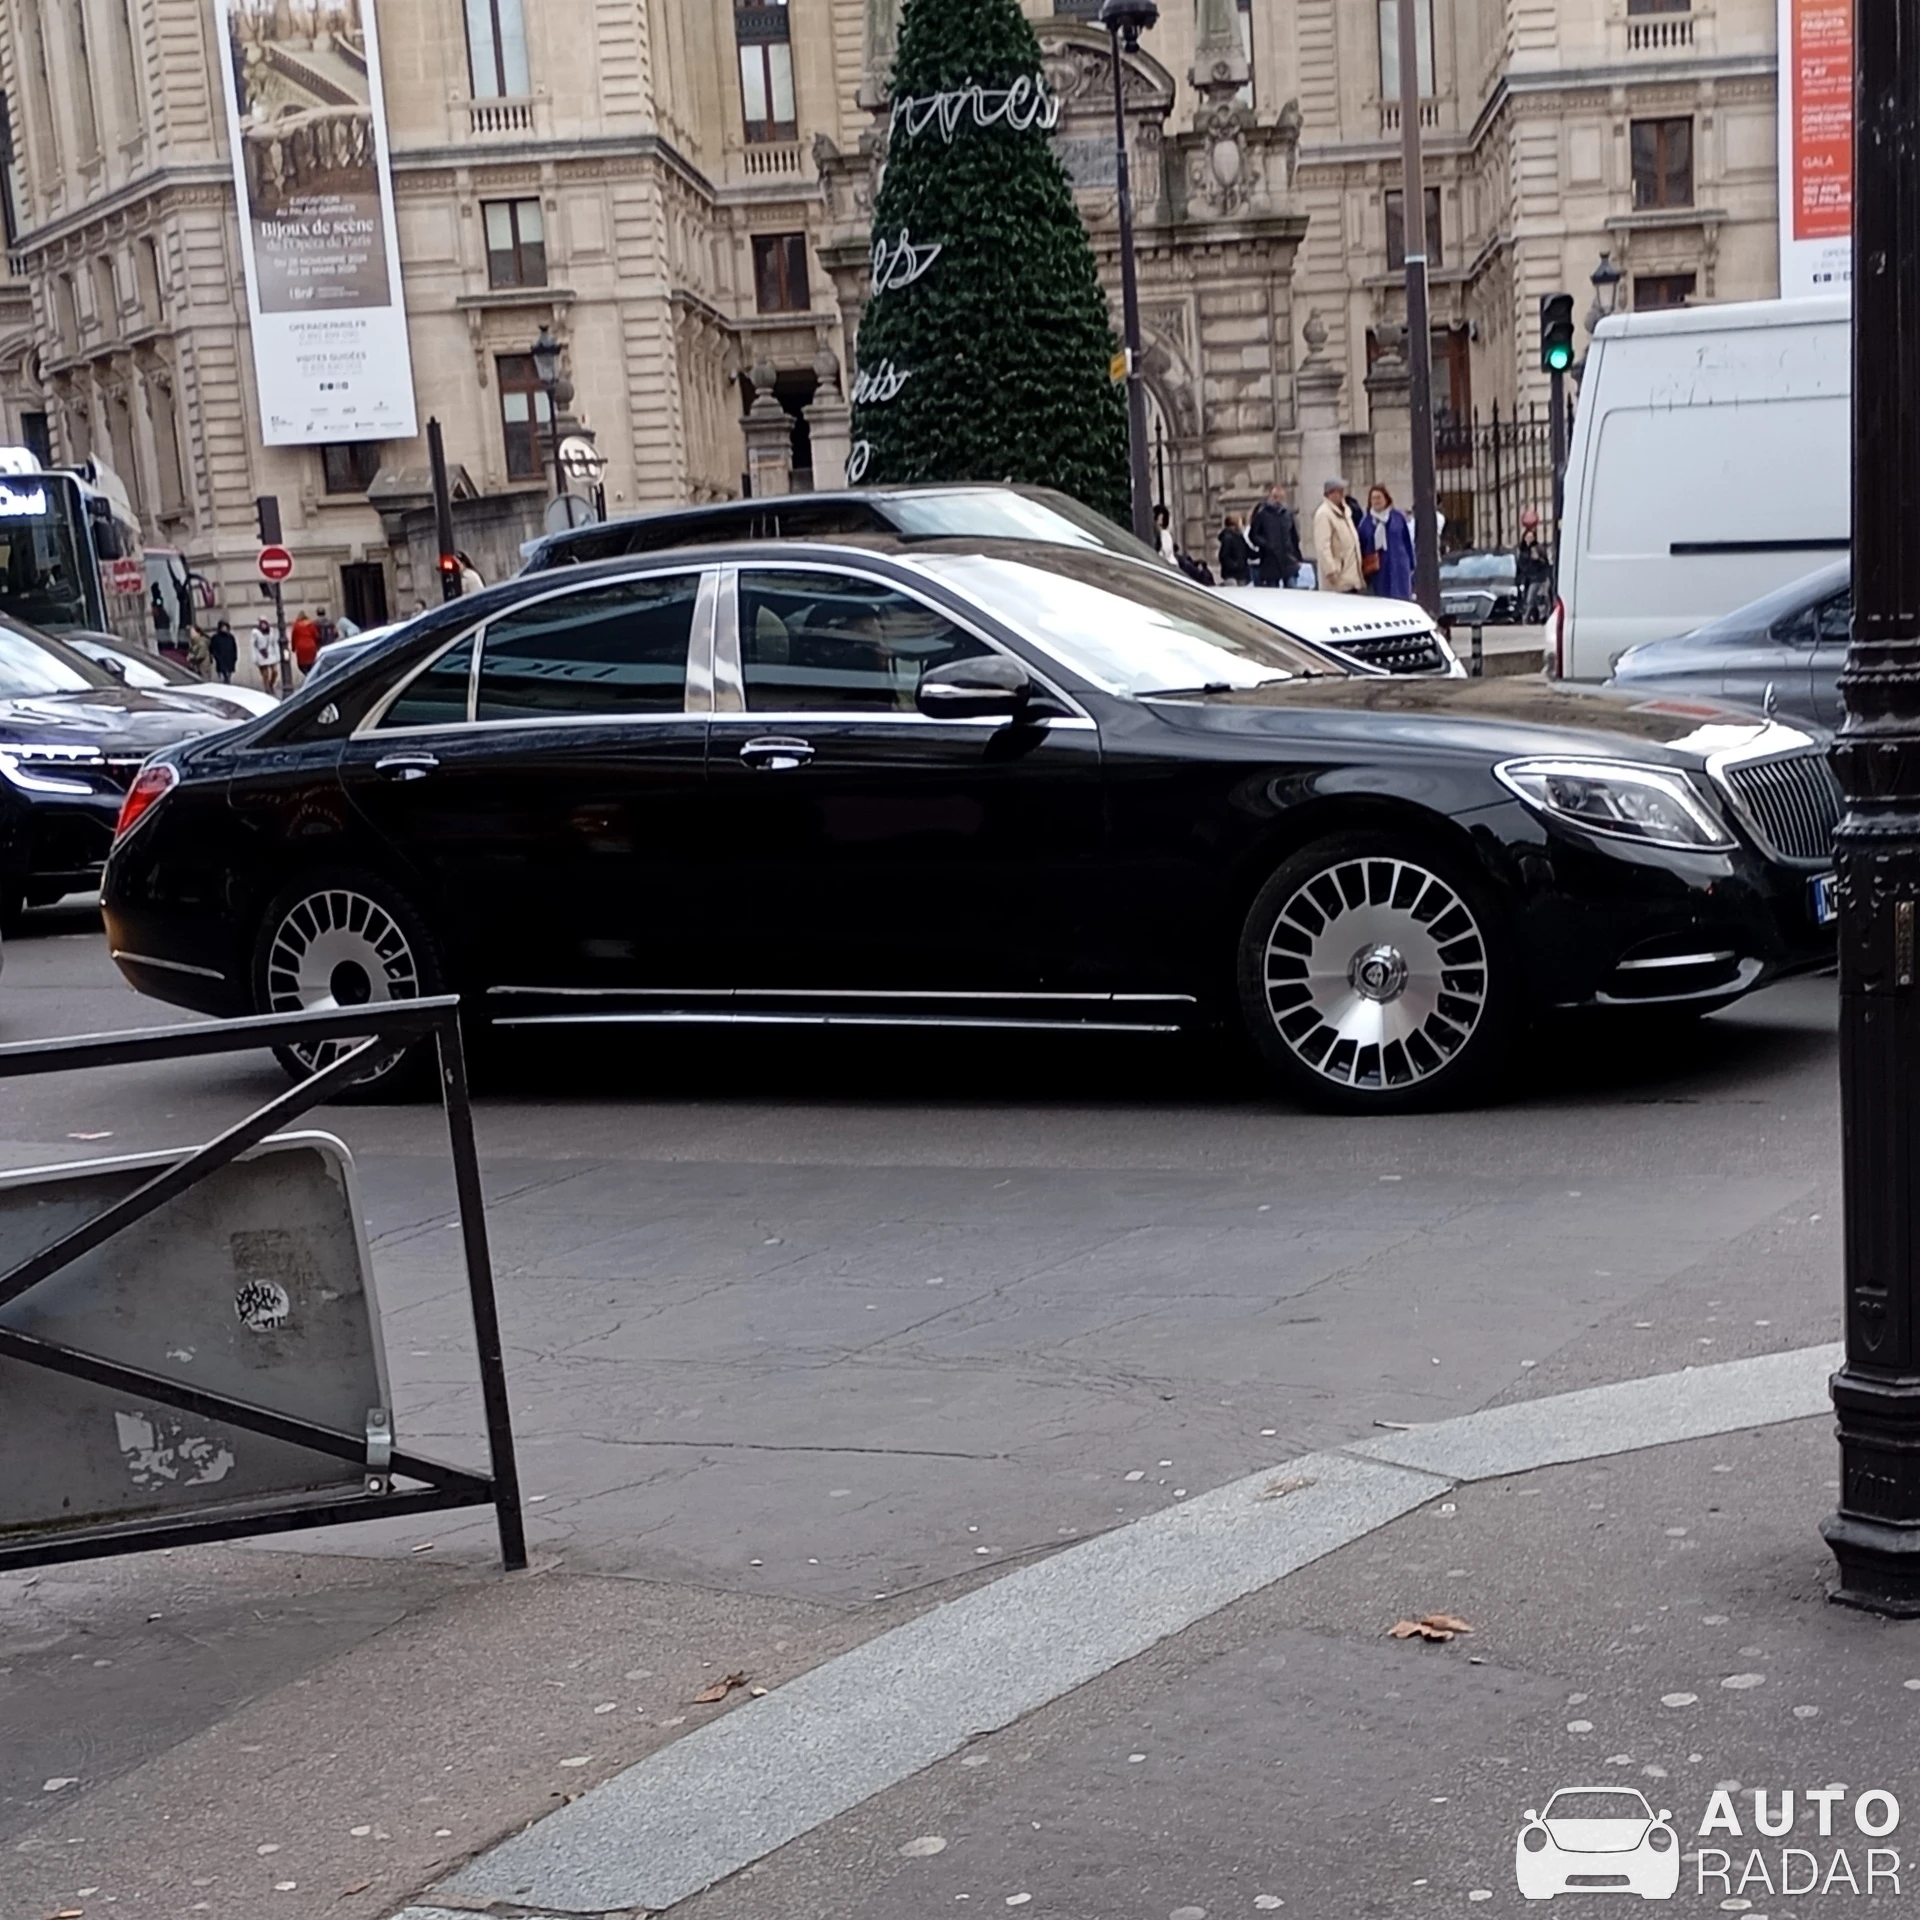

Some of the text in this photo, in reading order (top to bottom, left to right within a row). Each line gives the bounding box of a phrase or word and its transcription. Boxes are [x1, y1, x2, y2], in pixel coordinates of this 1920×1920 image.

[1802, 154, 1835, 169] GALA
[261, 215, 374, 240] Bijoux de scène
